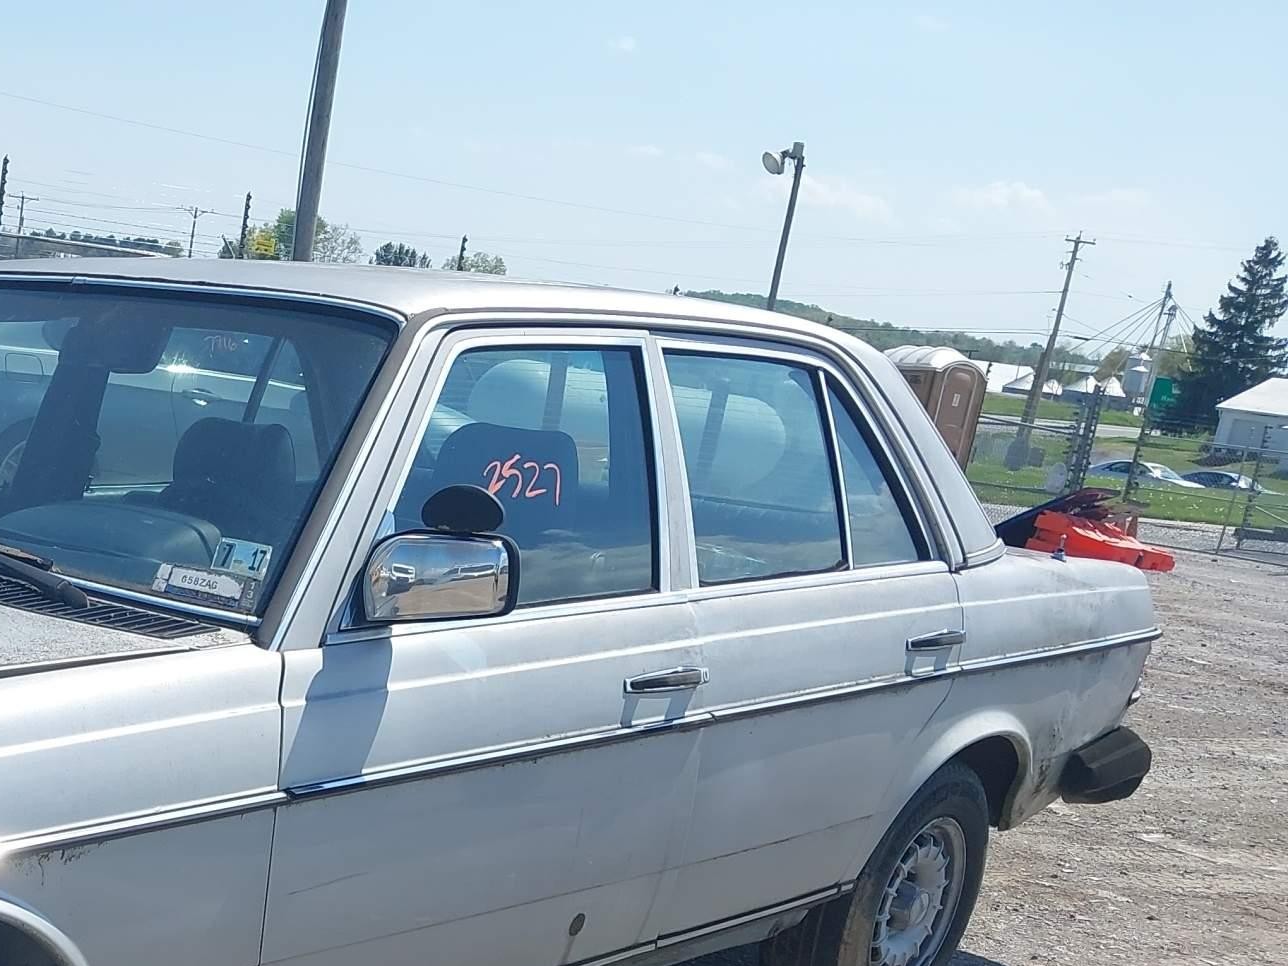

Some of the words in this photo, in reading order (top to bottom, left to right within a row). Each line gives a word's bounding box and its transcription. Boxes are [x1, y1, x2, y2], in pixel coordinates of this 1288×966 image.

[483, 454, 560, 505] 2527
[221, 543, 234, 566] 7
[248, 547, 267, 572] 17
